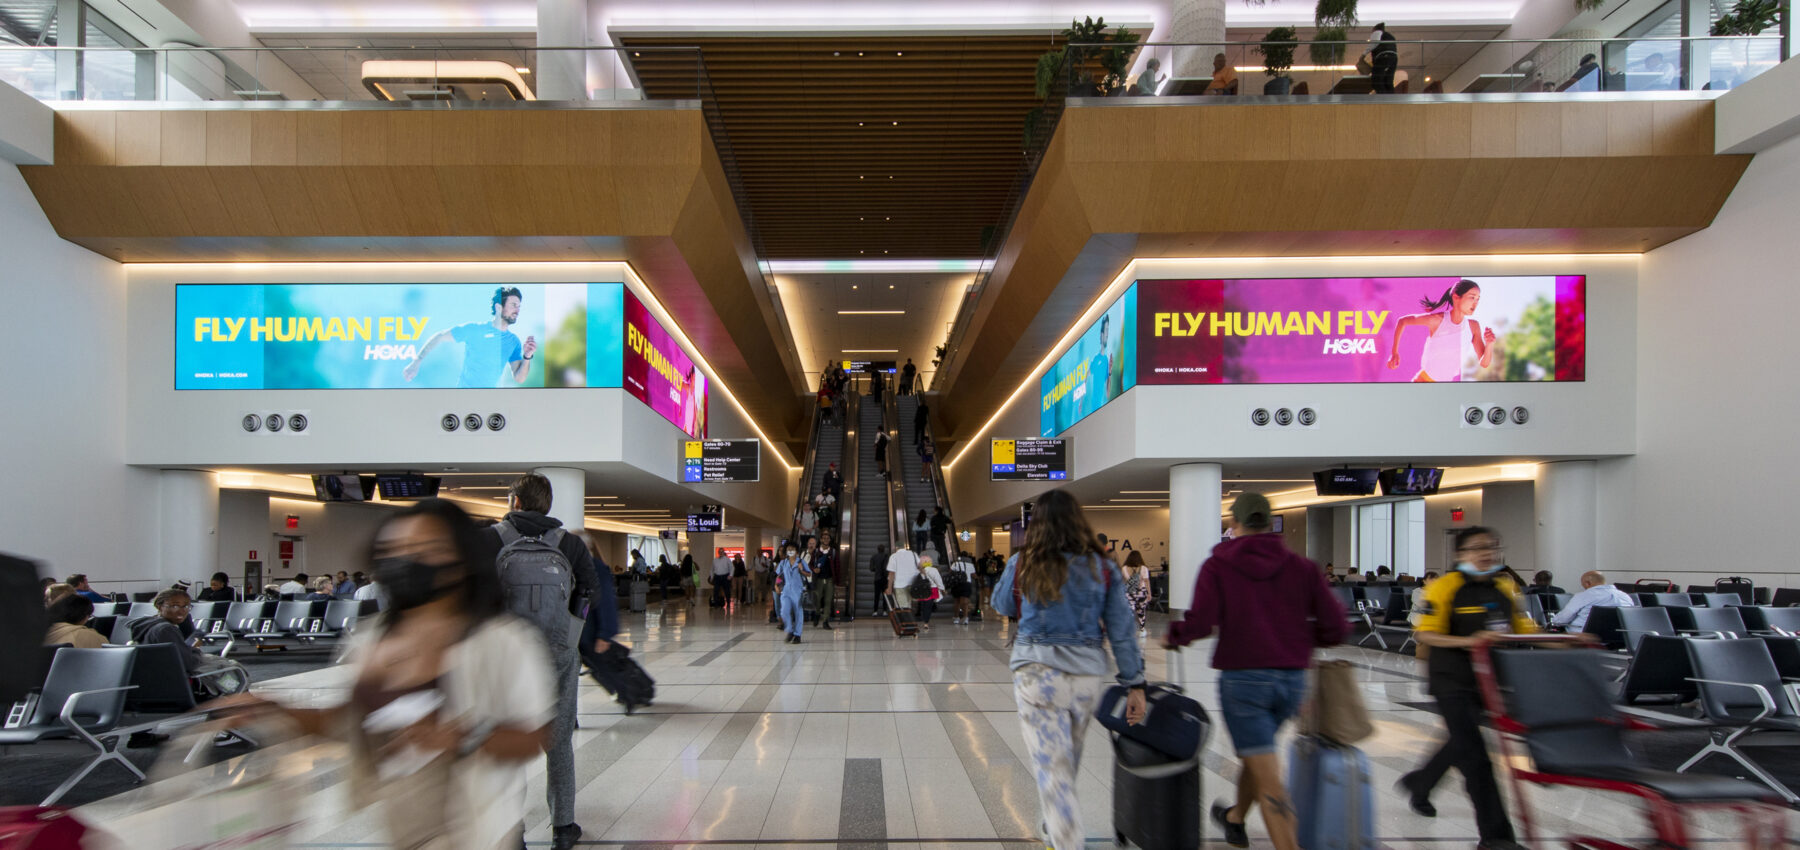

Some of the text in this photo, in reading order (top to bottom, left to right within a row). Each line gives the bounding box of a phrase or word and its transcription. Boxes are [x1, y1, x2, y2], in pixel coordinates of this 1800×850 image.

[194, 316, 430, 342] FLY HUMAN FLY
[1154, 310, 1390, 337] FLY HUMAN FLY
[363, 344, 419, 360] HOKA
[627, 321, 644, 355] FLY
[643, 337, 673, 381] HUMAN
[672, 368, 684, 391] FLY
[1322, 338, 1378, 355] HOKA
[1043, 357, 1089, 412] FLY HUMAN FLY
